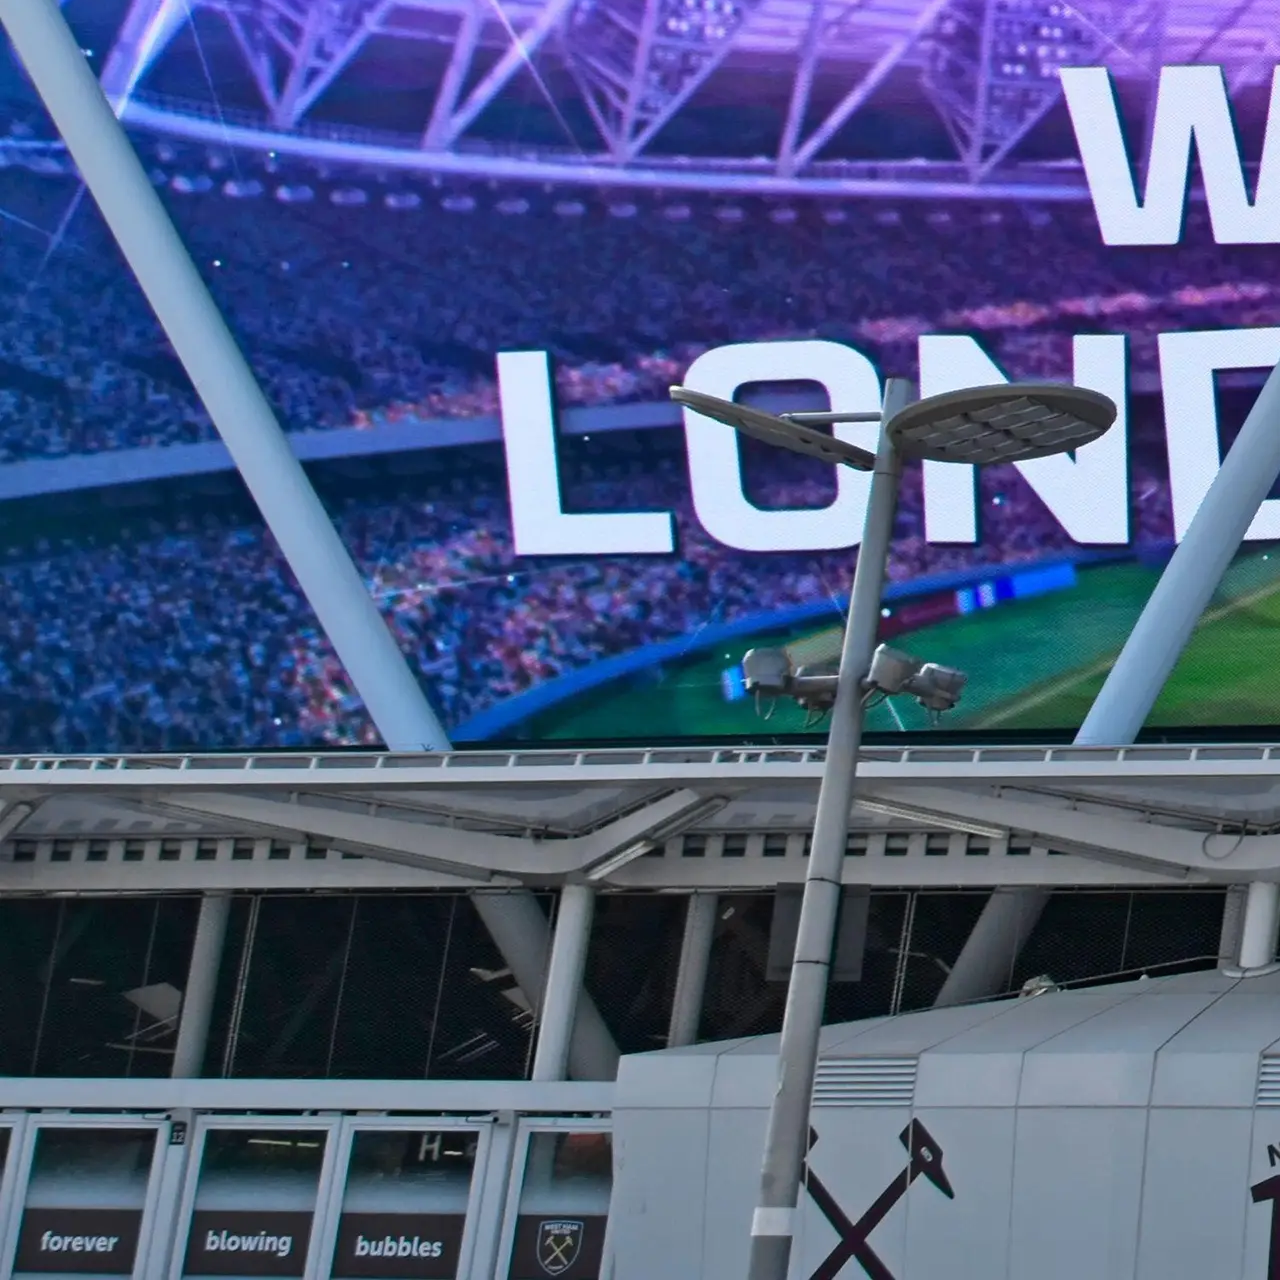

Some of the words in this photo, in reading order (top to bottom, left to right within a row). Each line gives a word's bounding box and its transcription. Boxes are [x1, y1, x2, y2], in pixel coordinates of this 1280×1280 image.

[41, 1231, 119, 1252] forever
[205, 1230, 292, 1257] blowing
[355, 1235, 442, 1258] bubbles
